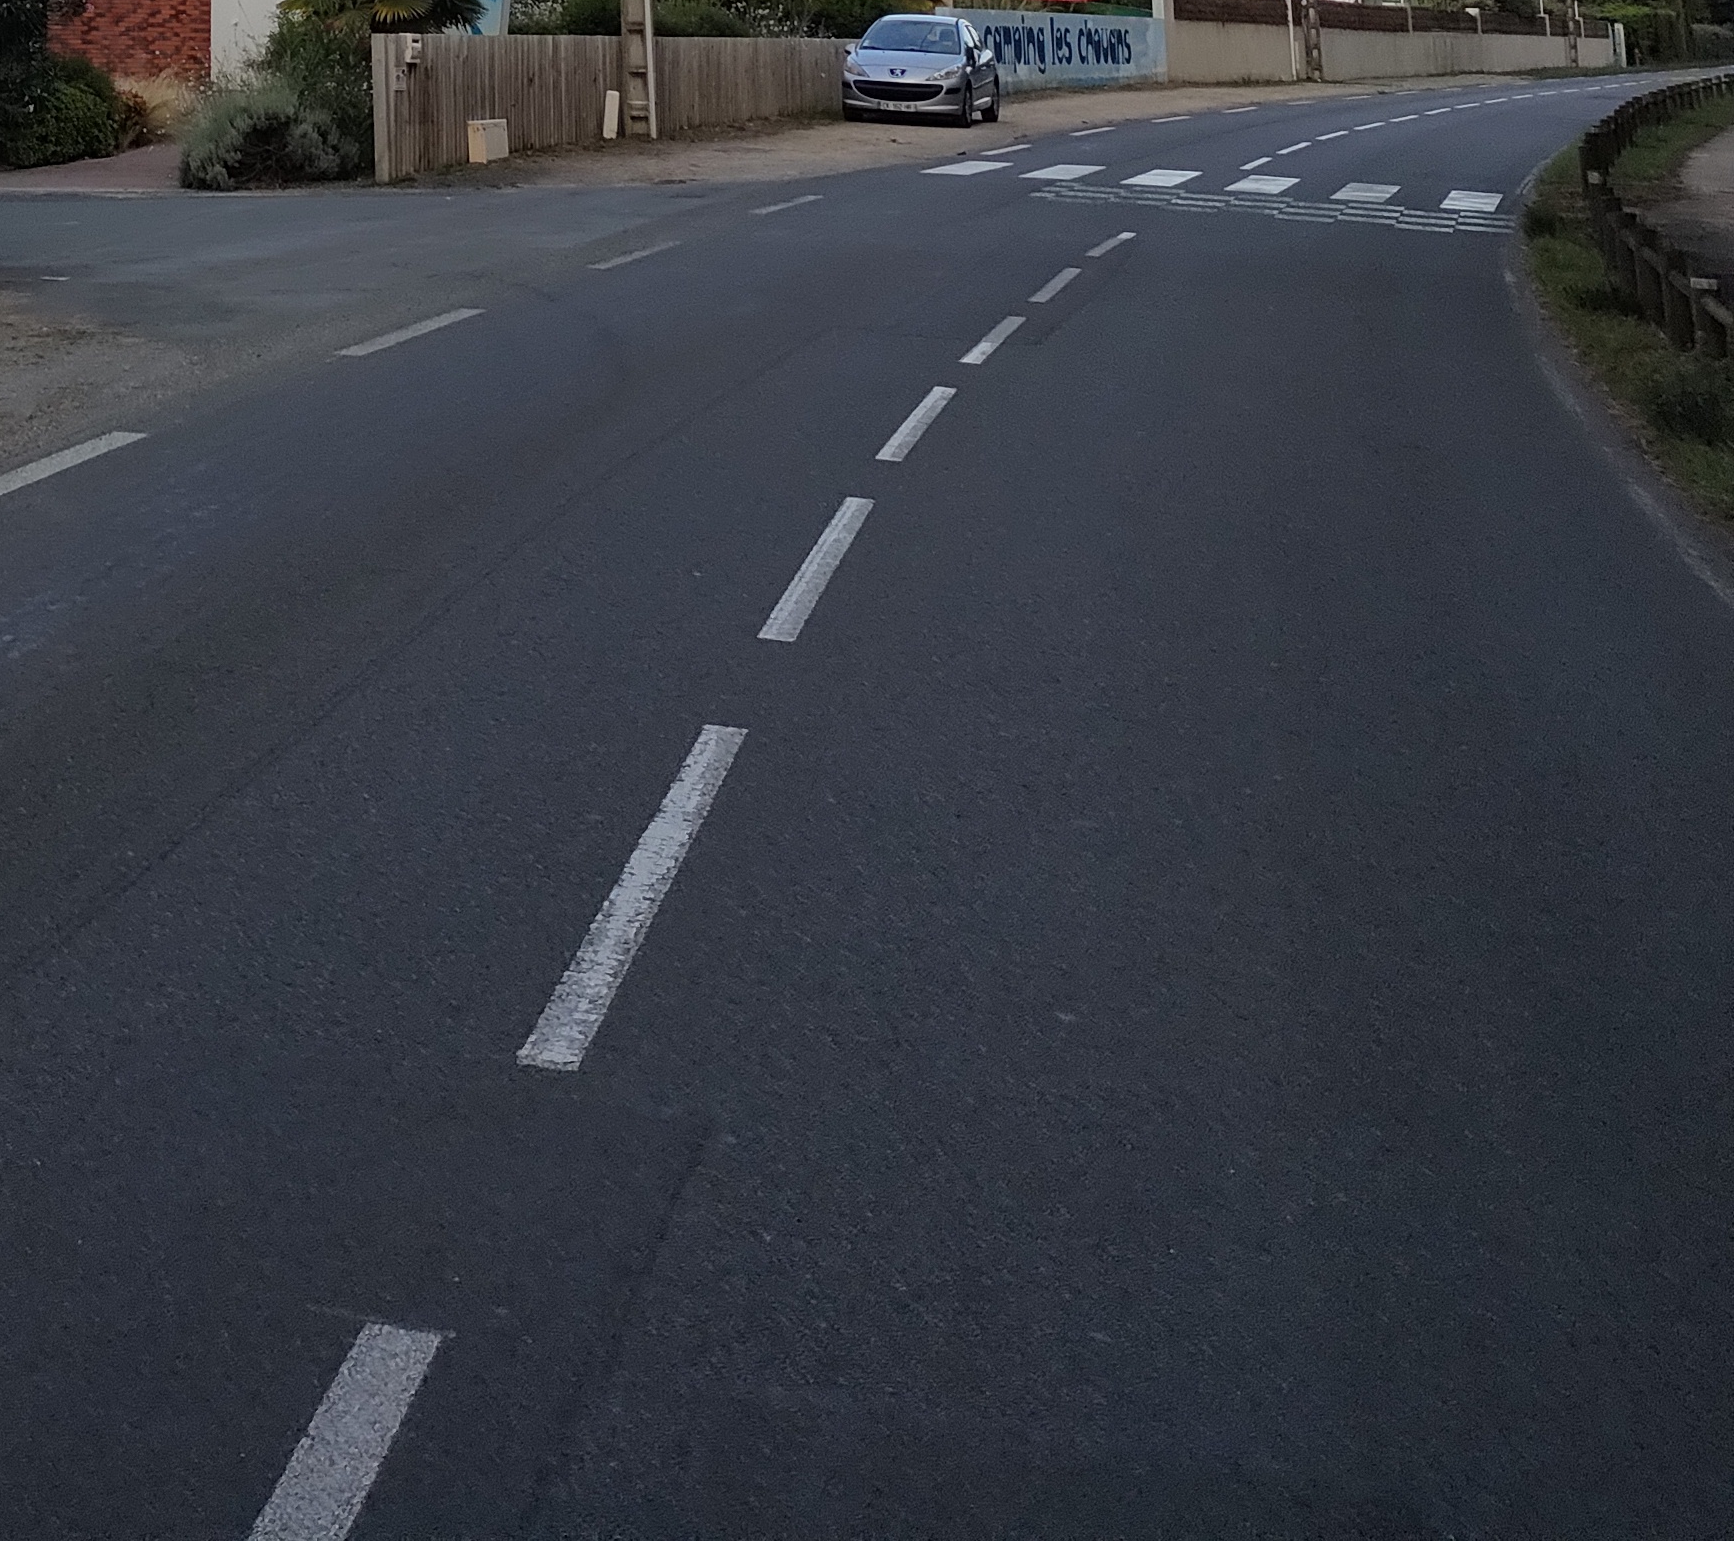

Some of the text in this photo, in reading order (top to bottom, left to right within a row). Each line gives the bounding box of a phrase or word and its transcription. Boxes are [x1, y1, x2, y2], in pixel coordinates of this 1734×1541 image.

[983, 14, 1132, 74] camping les chouans
